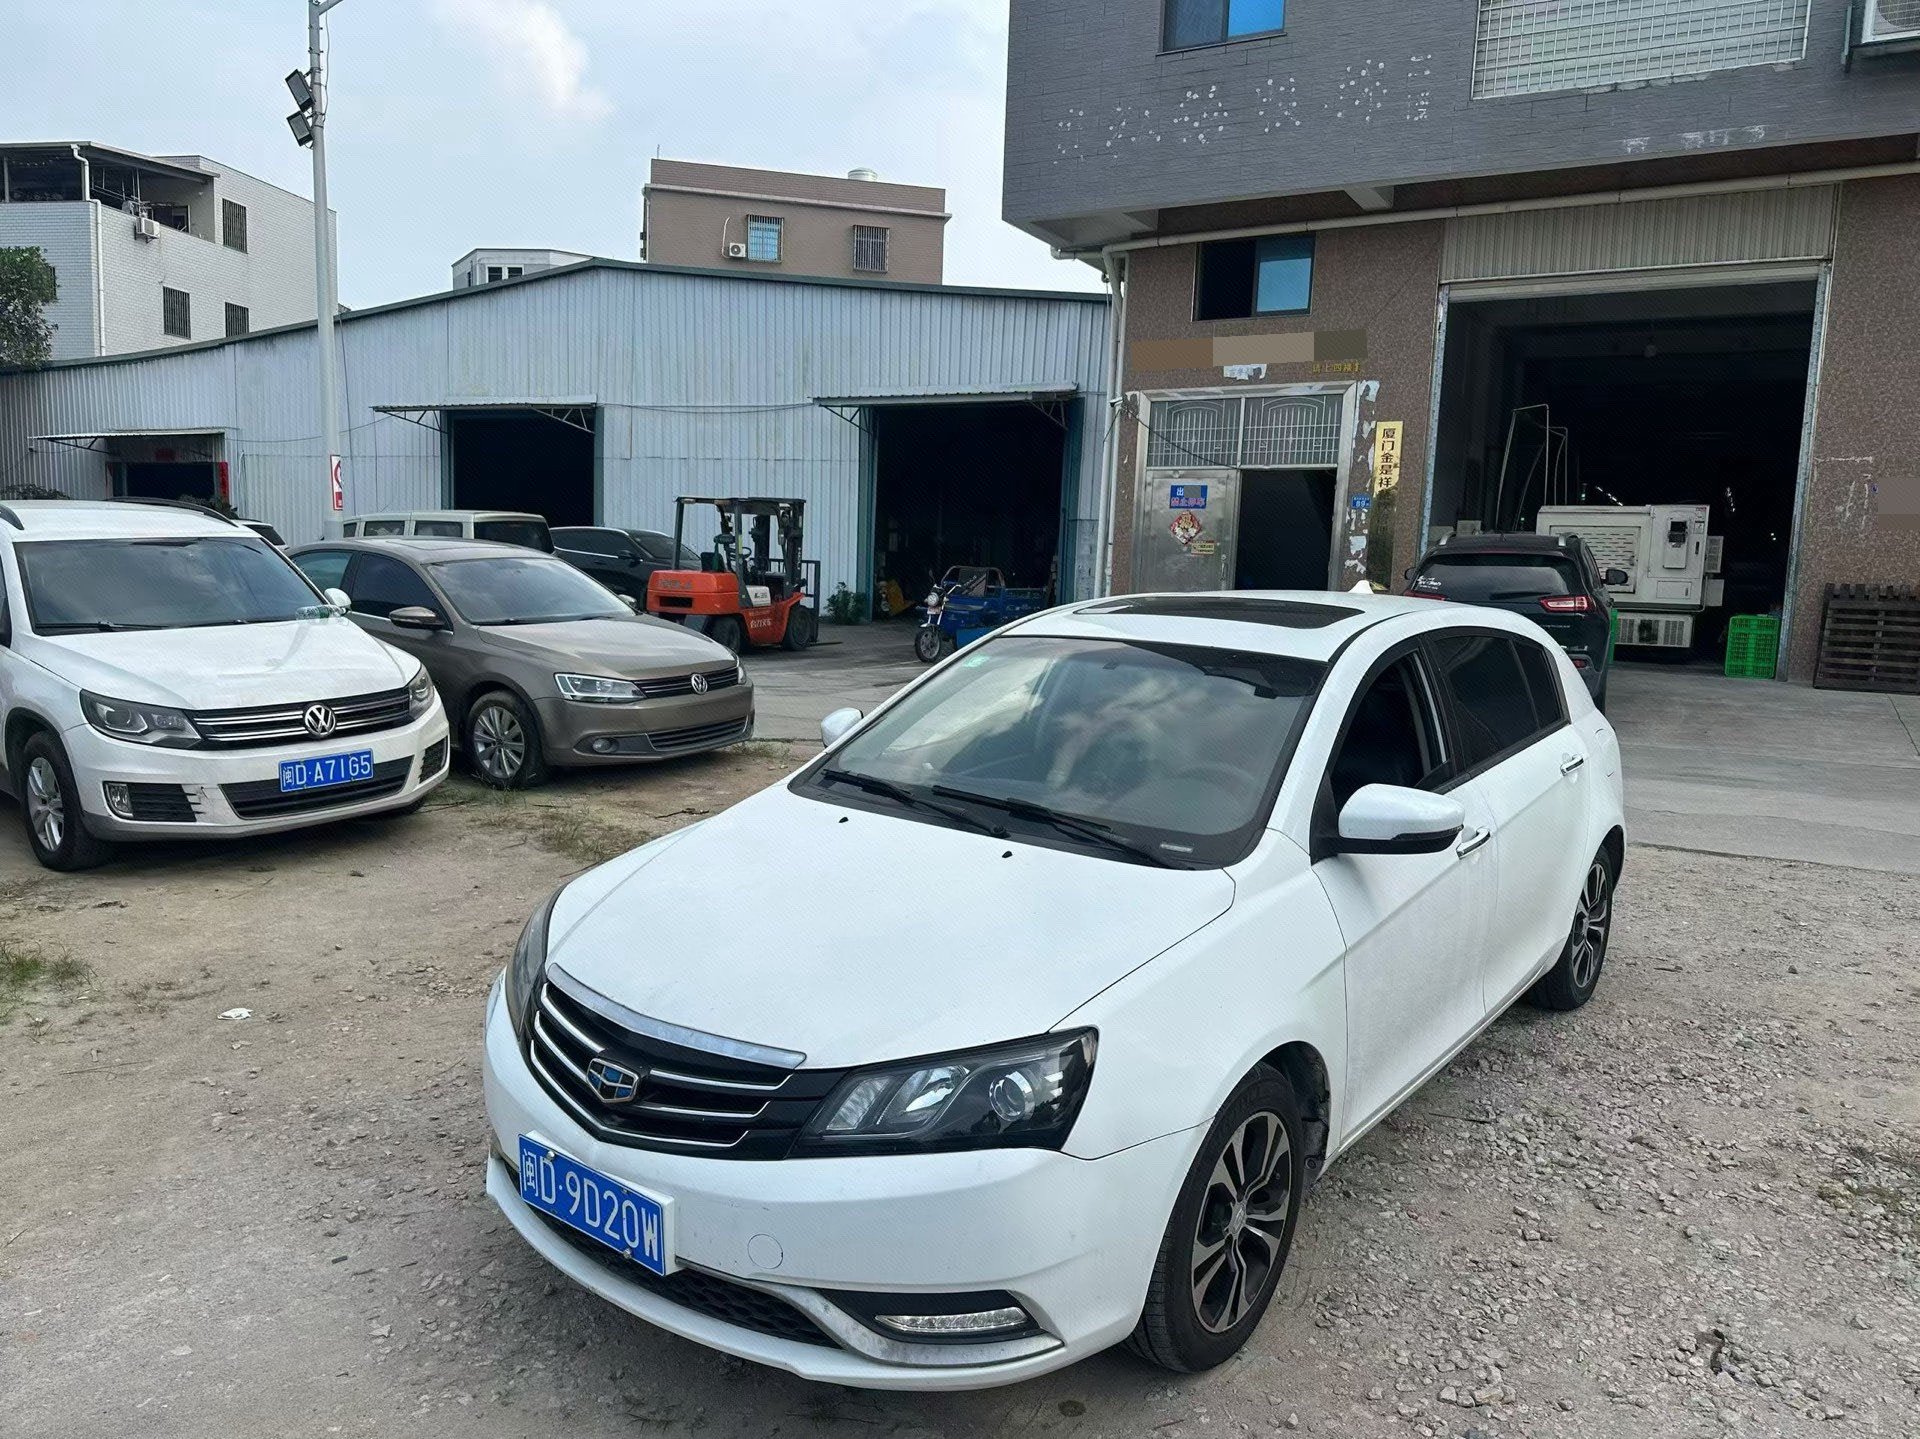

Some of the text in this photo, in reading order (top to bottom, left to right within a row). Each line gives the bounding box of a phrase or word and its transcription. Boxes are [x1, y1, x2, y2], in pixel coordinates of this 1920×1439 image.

[1378, 427, 1397, 488] 厦门金是祥
